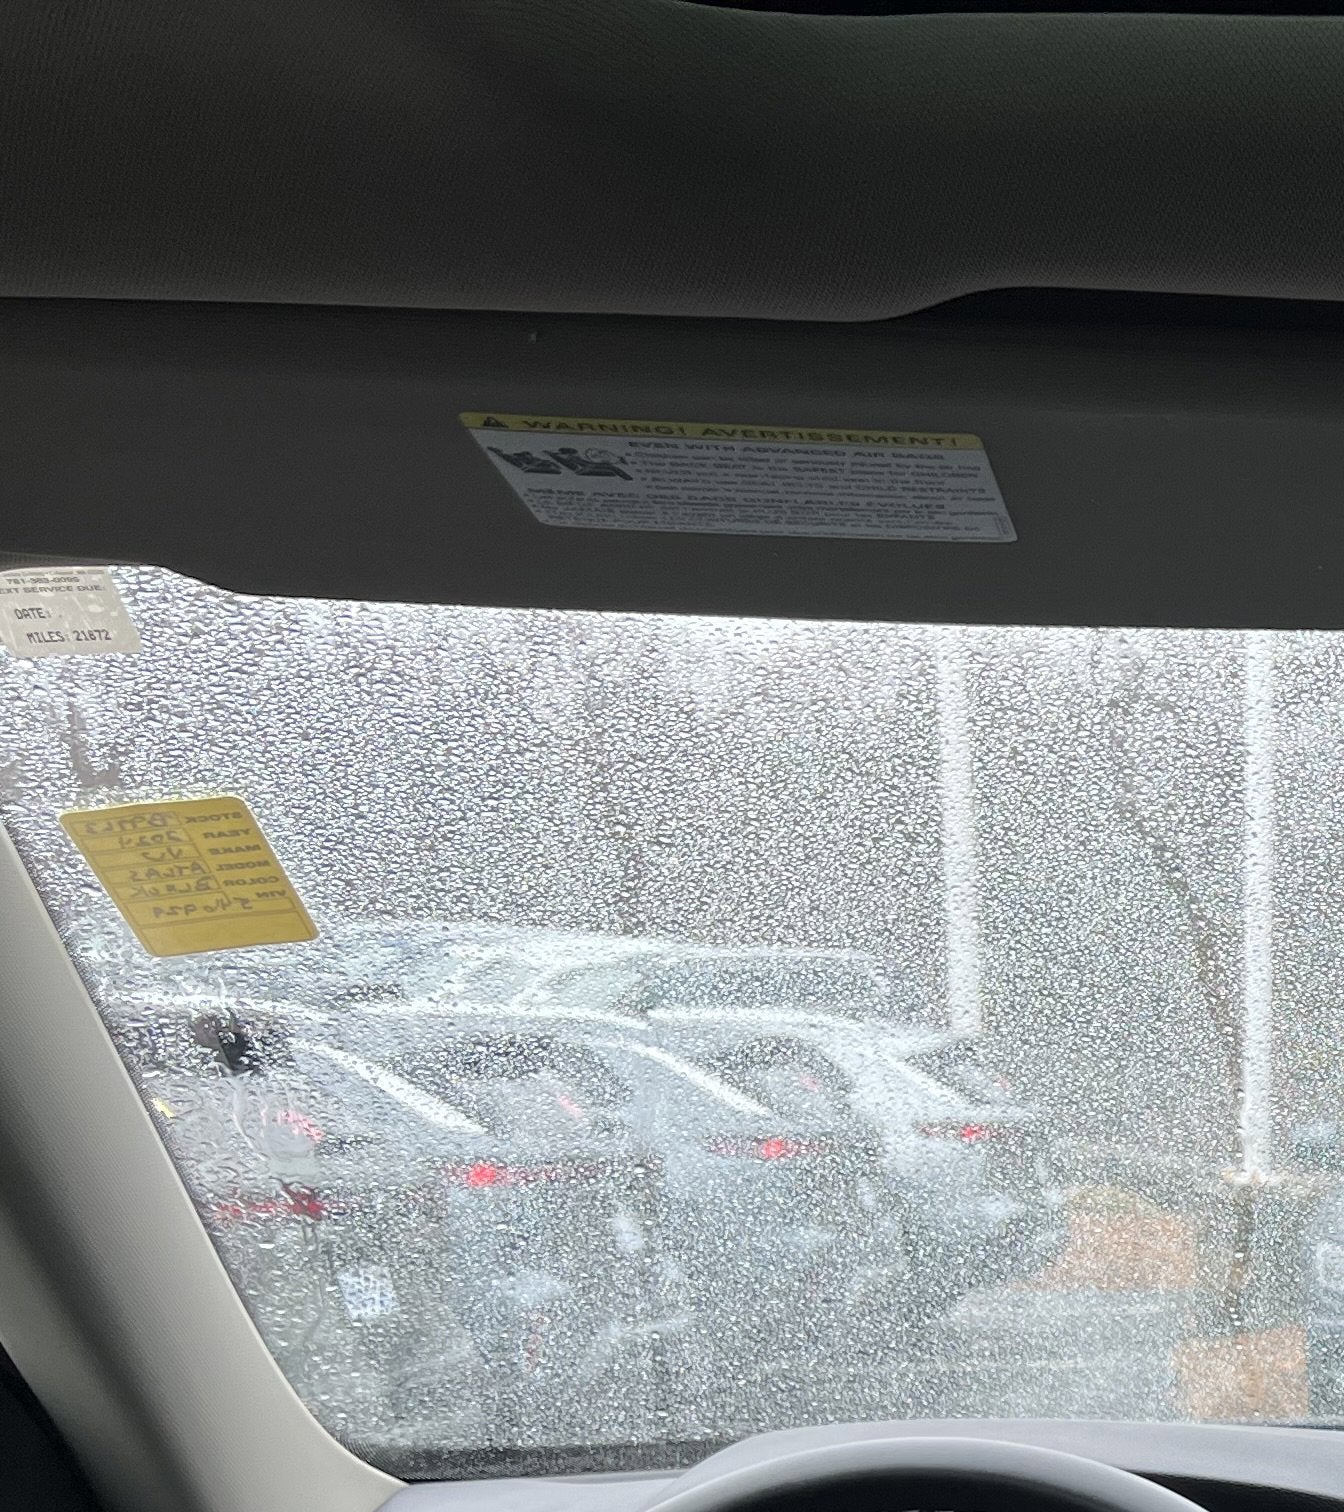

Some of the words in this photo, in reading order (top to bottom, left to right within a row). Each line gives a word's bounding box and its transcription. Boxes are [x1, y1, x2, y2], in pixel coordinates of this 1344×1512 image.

[522, 419, 687, 436] WARNING!
[701, 425, 958, 448] AVERTISSEMENT!
[0, 586, 19, 594] EXT
[23, 585, 74, 593] SERVICE
